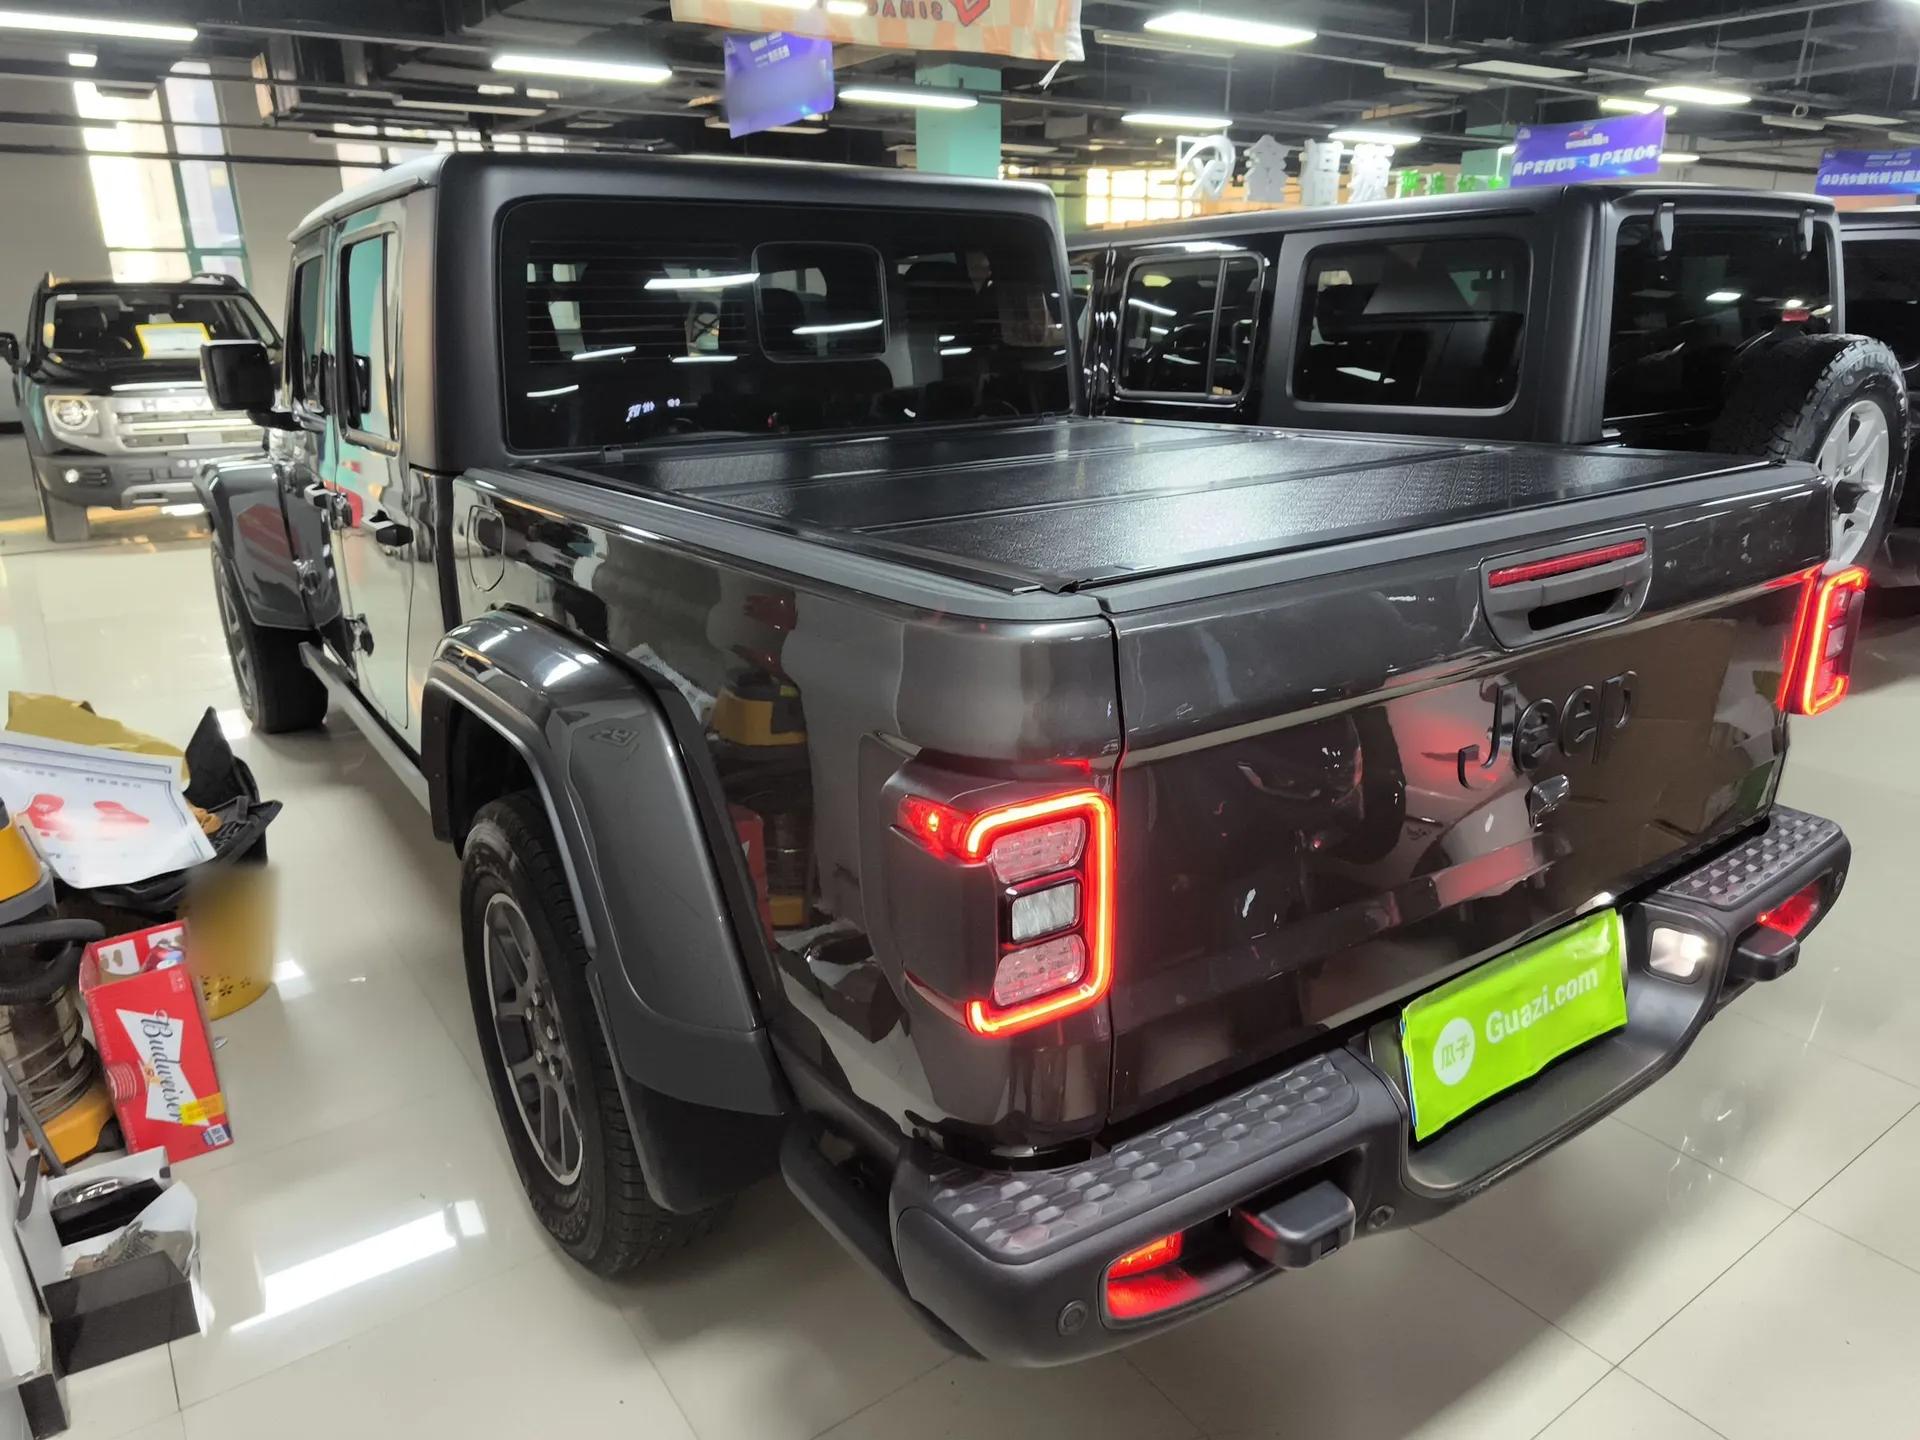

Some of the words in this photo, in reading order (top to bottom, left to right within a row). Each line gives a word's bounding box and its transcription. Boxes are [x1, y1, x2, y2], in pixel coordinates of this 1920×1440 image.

[1457, 671, 1638, 790] Jeep
[1440, 1034, 1471, 1071] 瓜子
[1485, 967, 1599, 1044] Guazi.com
[140, 1008, 184, 1122] Budweiser
